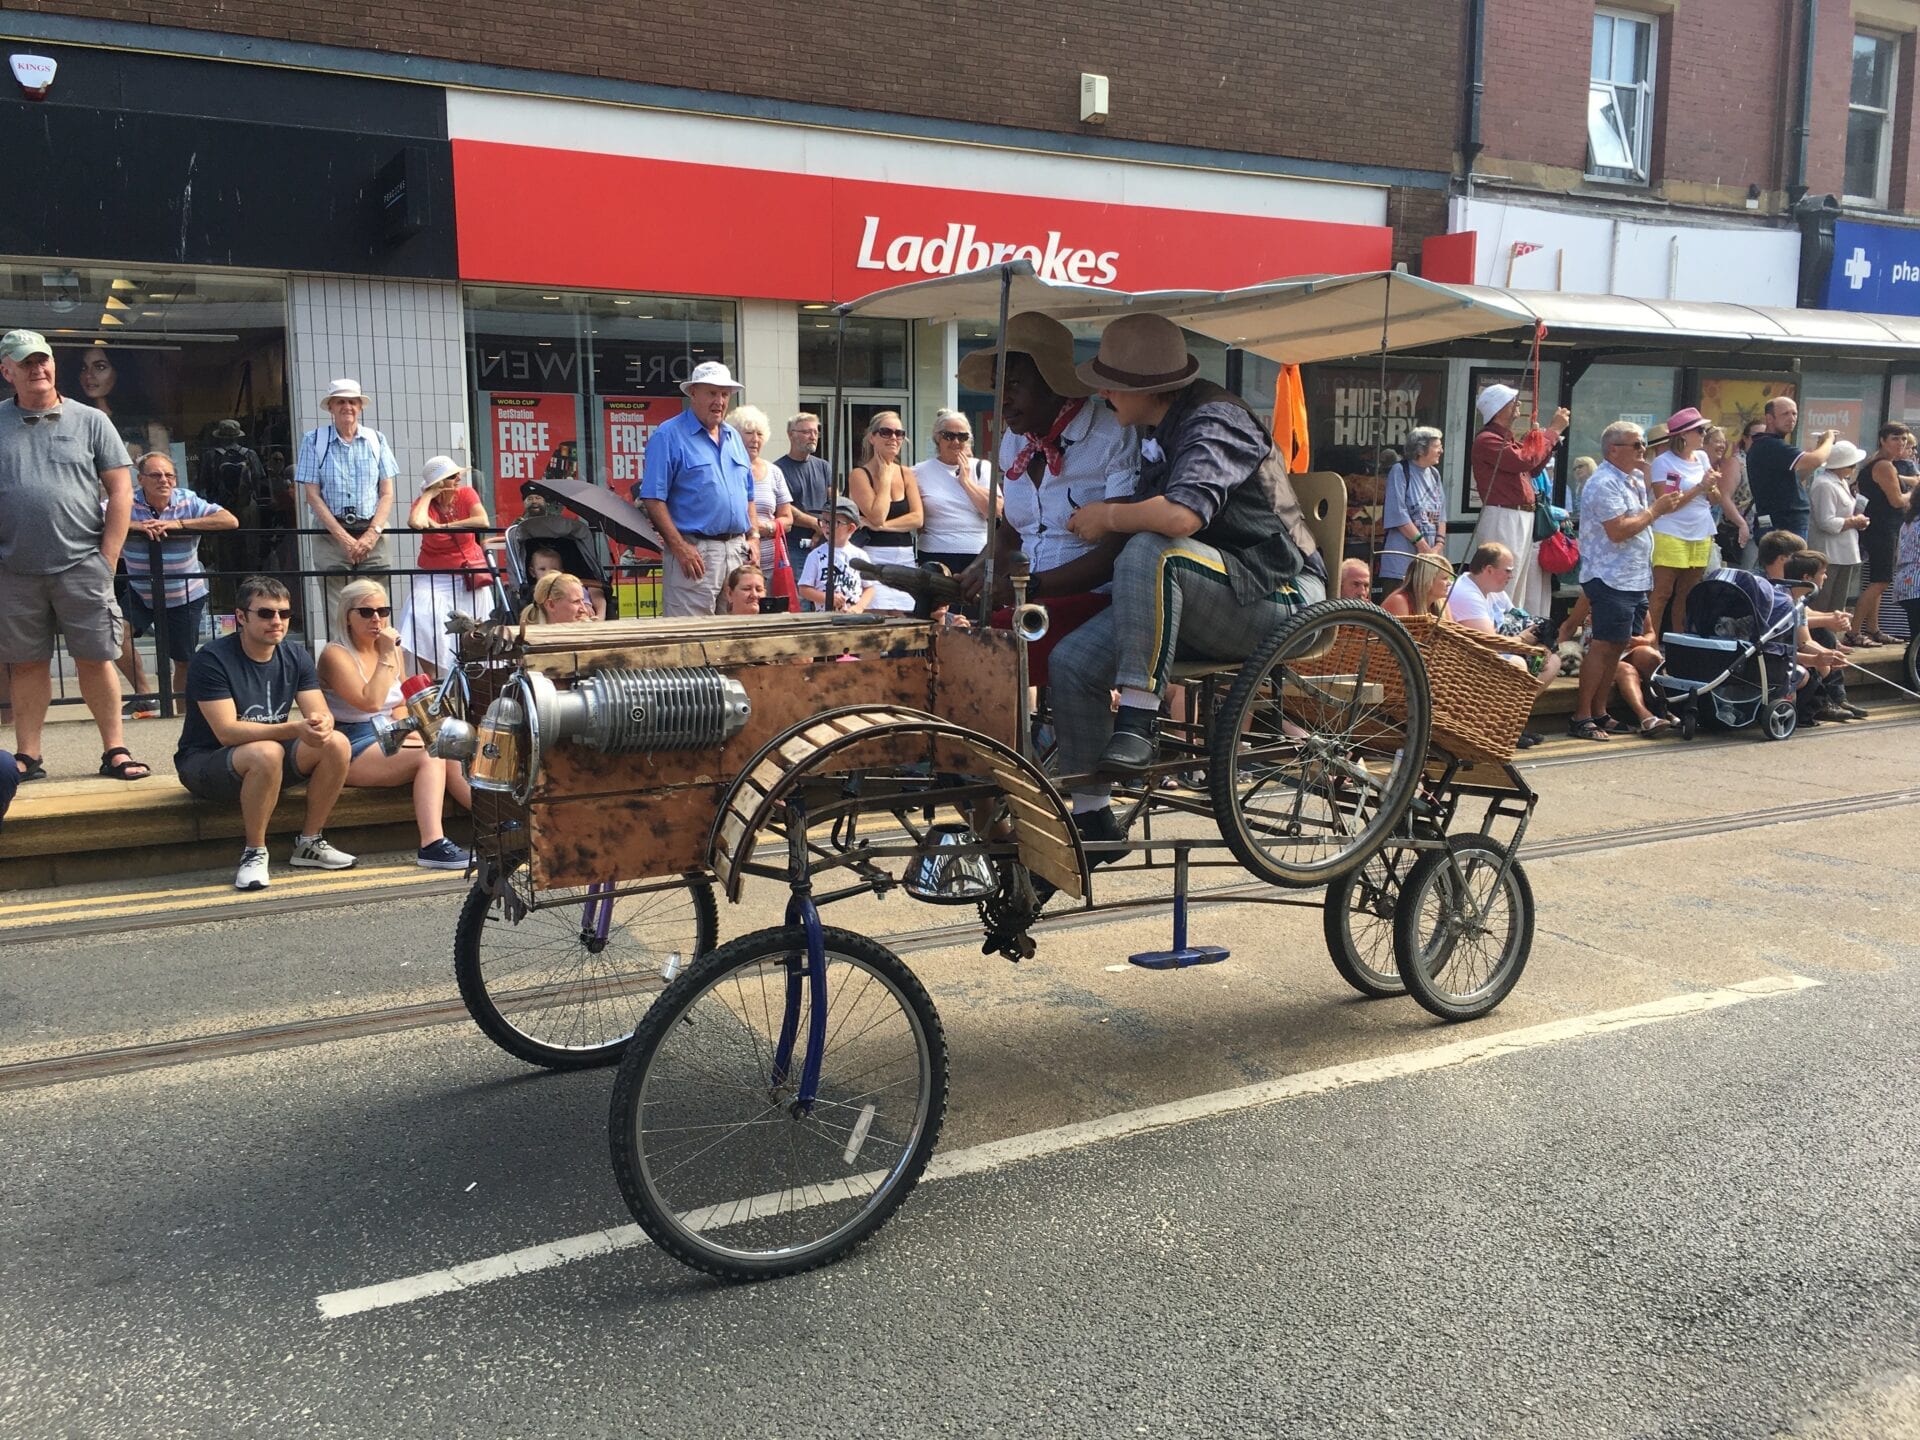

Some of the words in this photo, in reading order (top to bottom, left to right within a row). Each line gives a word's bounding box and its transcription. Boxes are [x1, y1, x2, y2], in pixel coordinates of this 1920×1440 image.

[17, 63, 51, 72] KINGS
[857, 216, 1120, 284] Ladbrokes
[1892, 260, 1920, 283] pha
[1335, 387, 1420, 417] HURRY
[498, 409, 534, 420] BetStation
[610, 412, 644, 423] BetStation
[1808, 409, 1837, 426] from
[498, 421, 550, 451] FREE
